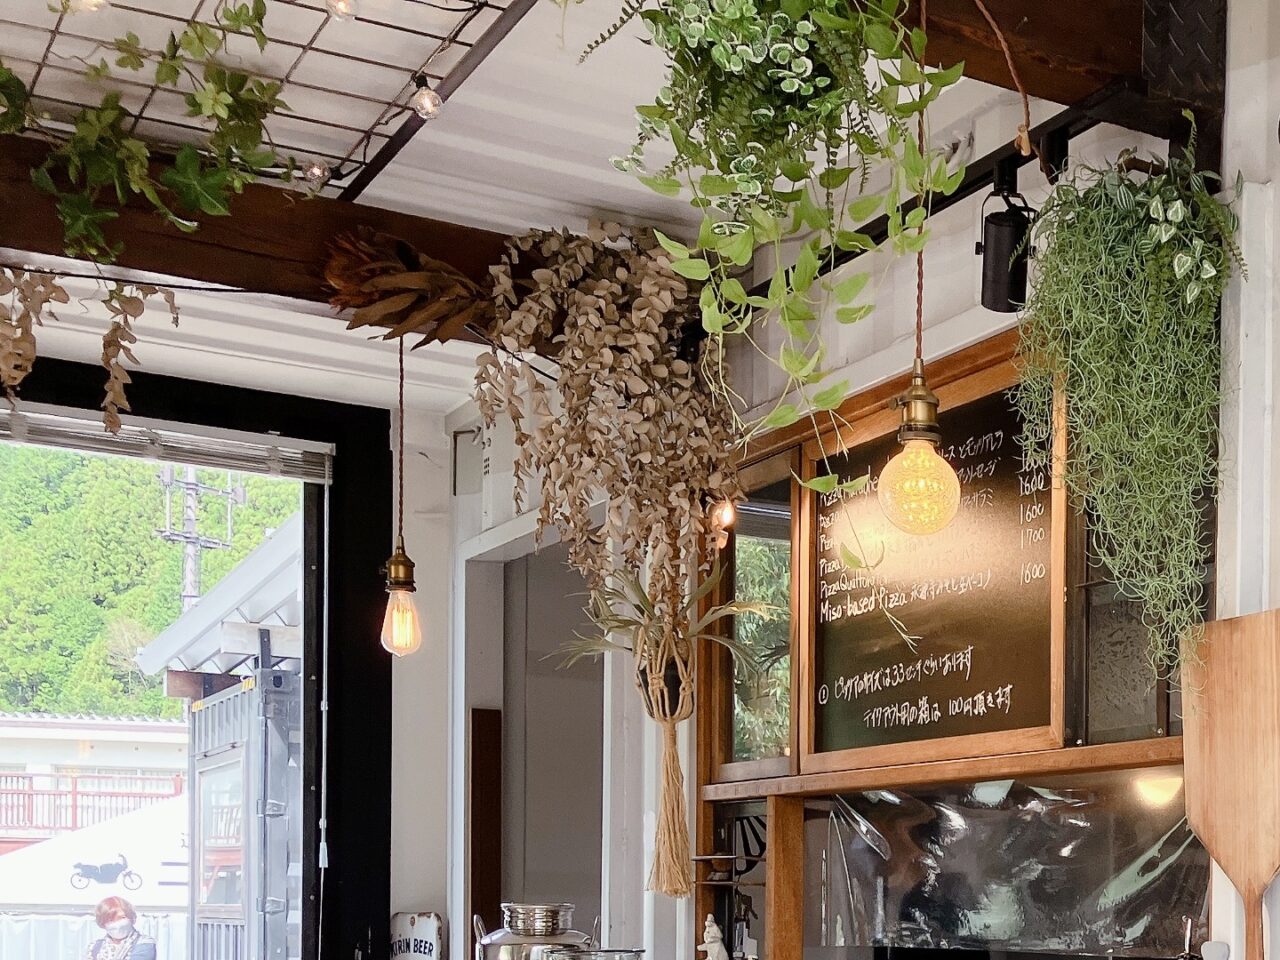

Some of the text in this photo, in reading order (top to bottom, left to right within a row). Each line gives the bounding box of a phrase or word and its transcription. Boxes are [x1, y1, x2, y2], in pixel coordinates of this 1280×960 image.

[1020, 527, 1045, 549] 1700
[1020, 562, 1046, 586] 1600
[413, 938, 434, 957] BEER
